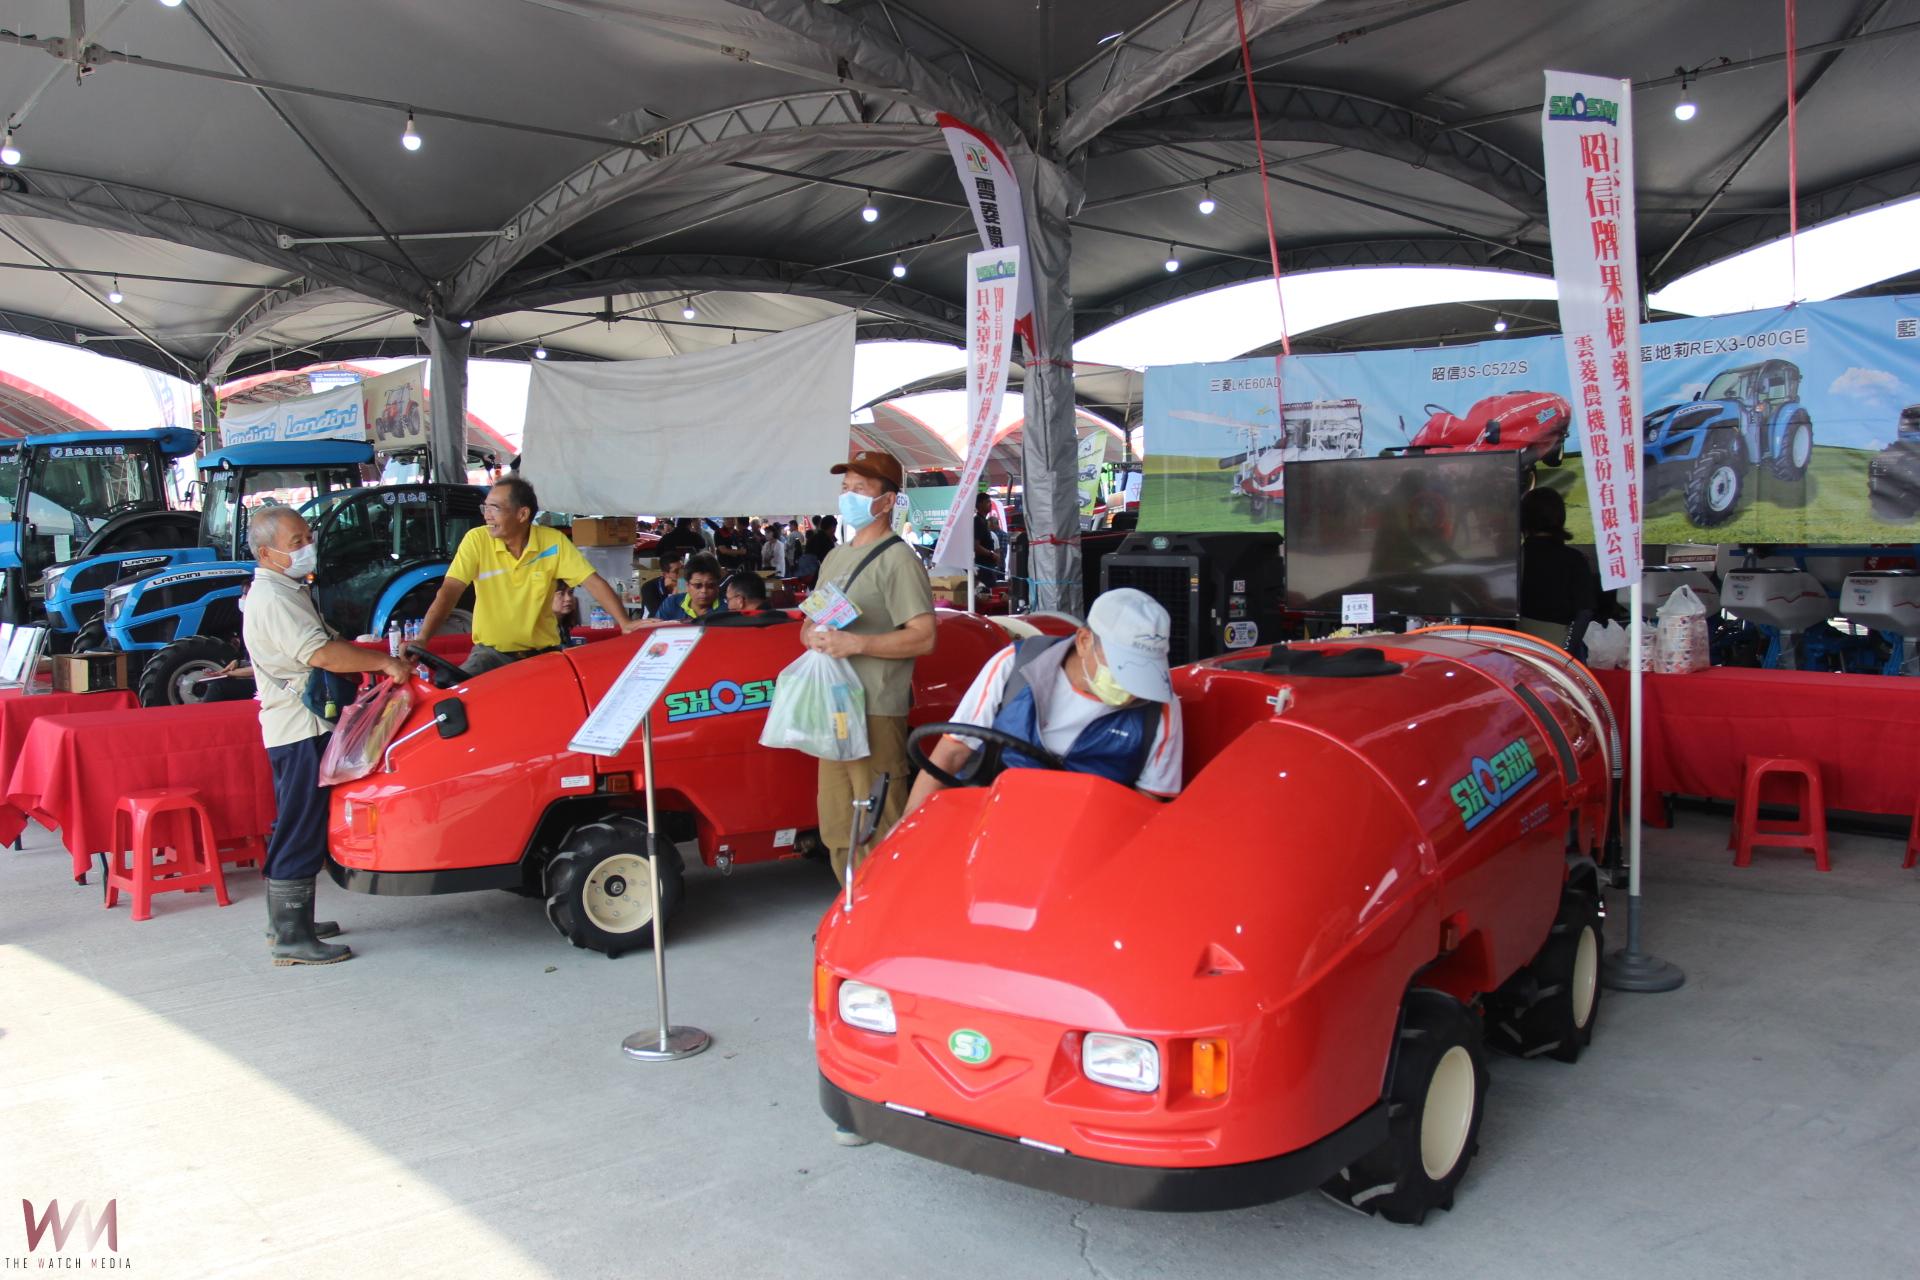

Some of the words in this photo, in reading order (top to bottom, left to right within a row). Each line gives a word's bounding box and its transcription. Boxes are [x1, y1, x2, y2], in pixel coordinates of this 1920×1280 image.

[1549, 93, 1618, 125] SHOSHIN
[1432, 361, 1528, 381] 昭信3S-C522S
[225, 422, 277, 446] Landini
[284, 404, 358, 438] Landini
[1574, 335, 1627, 579] 雲菱農機股份有限公司
[124, 555, 162, 567] LANDINI
[152, 572, 200, 586] LANDINI
[664, 679, 776, 716] SHOSH
[1450, 736, 1536, 826] SHOSHIN
